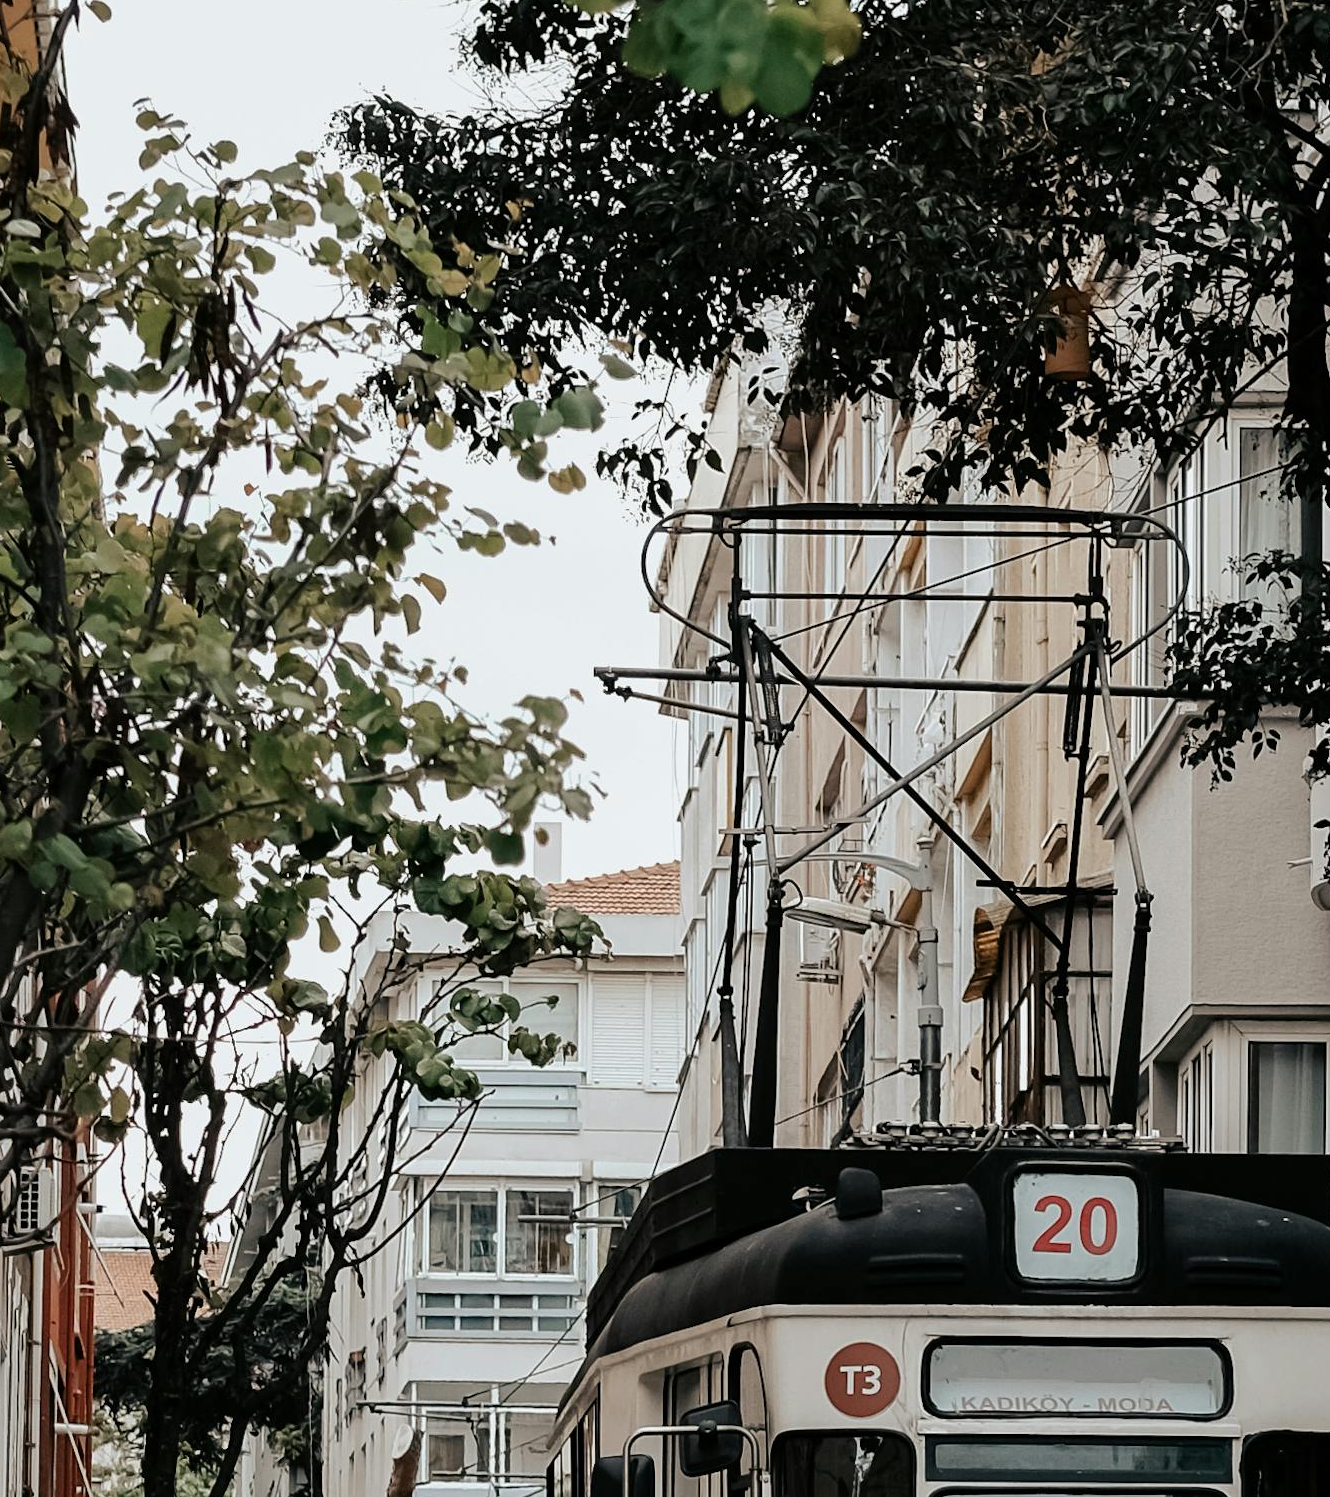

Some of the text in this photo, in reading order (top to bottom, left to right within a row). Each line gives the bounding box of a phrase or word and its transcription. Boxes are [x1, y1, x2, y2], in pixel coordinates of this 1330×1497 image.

[1032, 1195, 1118, 1255] 20
[839, 1364, 882, 1396] T3
[960, 1394, 1075, 1412] KADIKÖY
